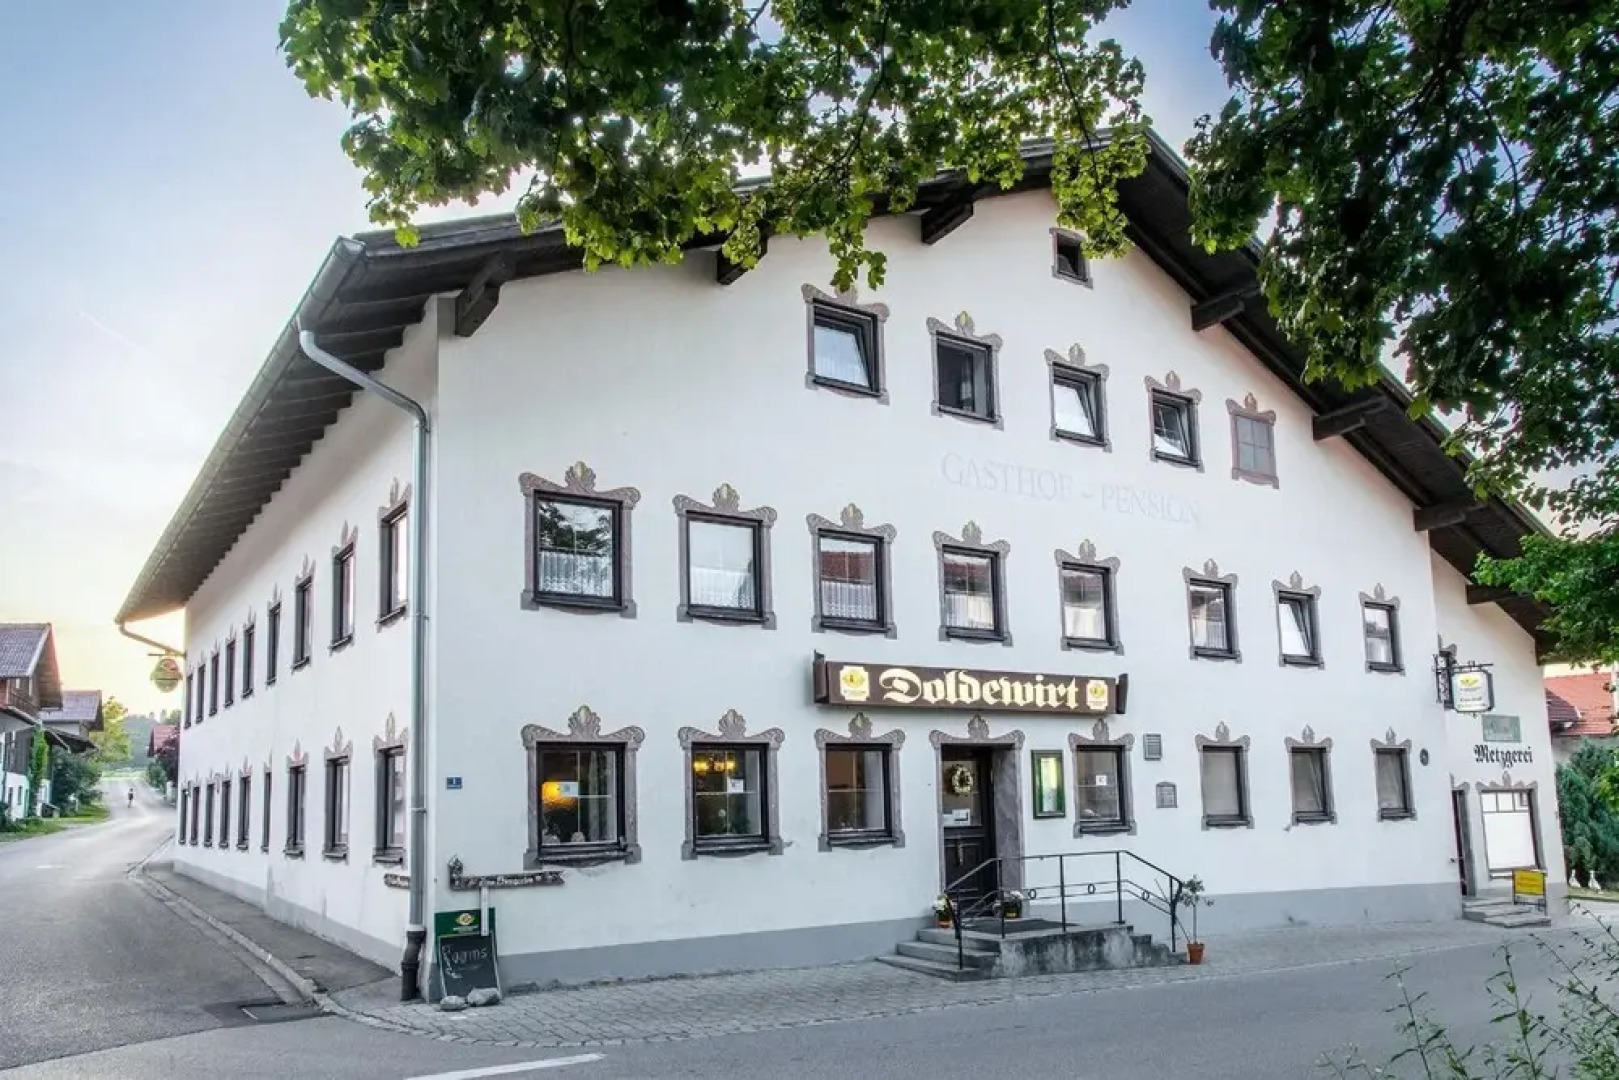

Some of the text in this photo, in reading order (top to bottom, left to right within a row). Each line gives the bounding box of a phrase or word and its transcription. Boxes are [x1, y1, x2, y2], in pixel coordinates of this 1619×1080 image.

[941, 452, 1073, 502] GASTHOF
[1100, 483, 1202, 527] PENSION
[879, 667, 1079, 710] Doldewirt
[1474, 744, 1533, 769] Metzgerei
